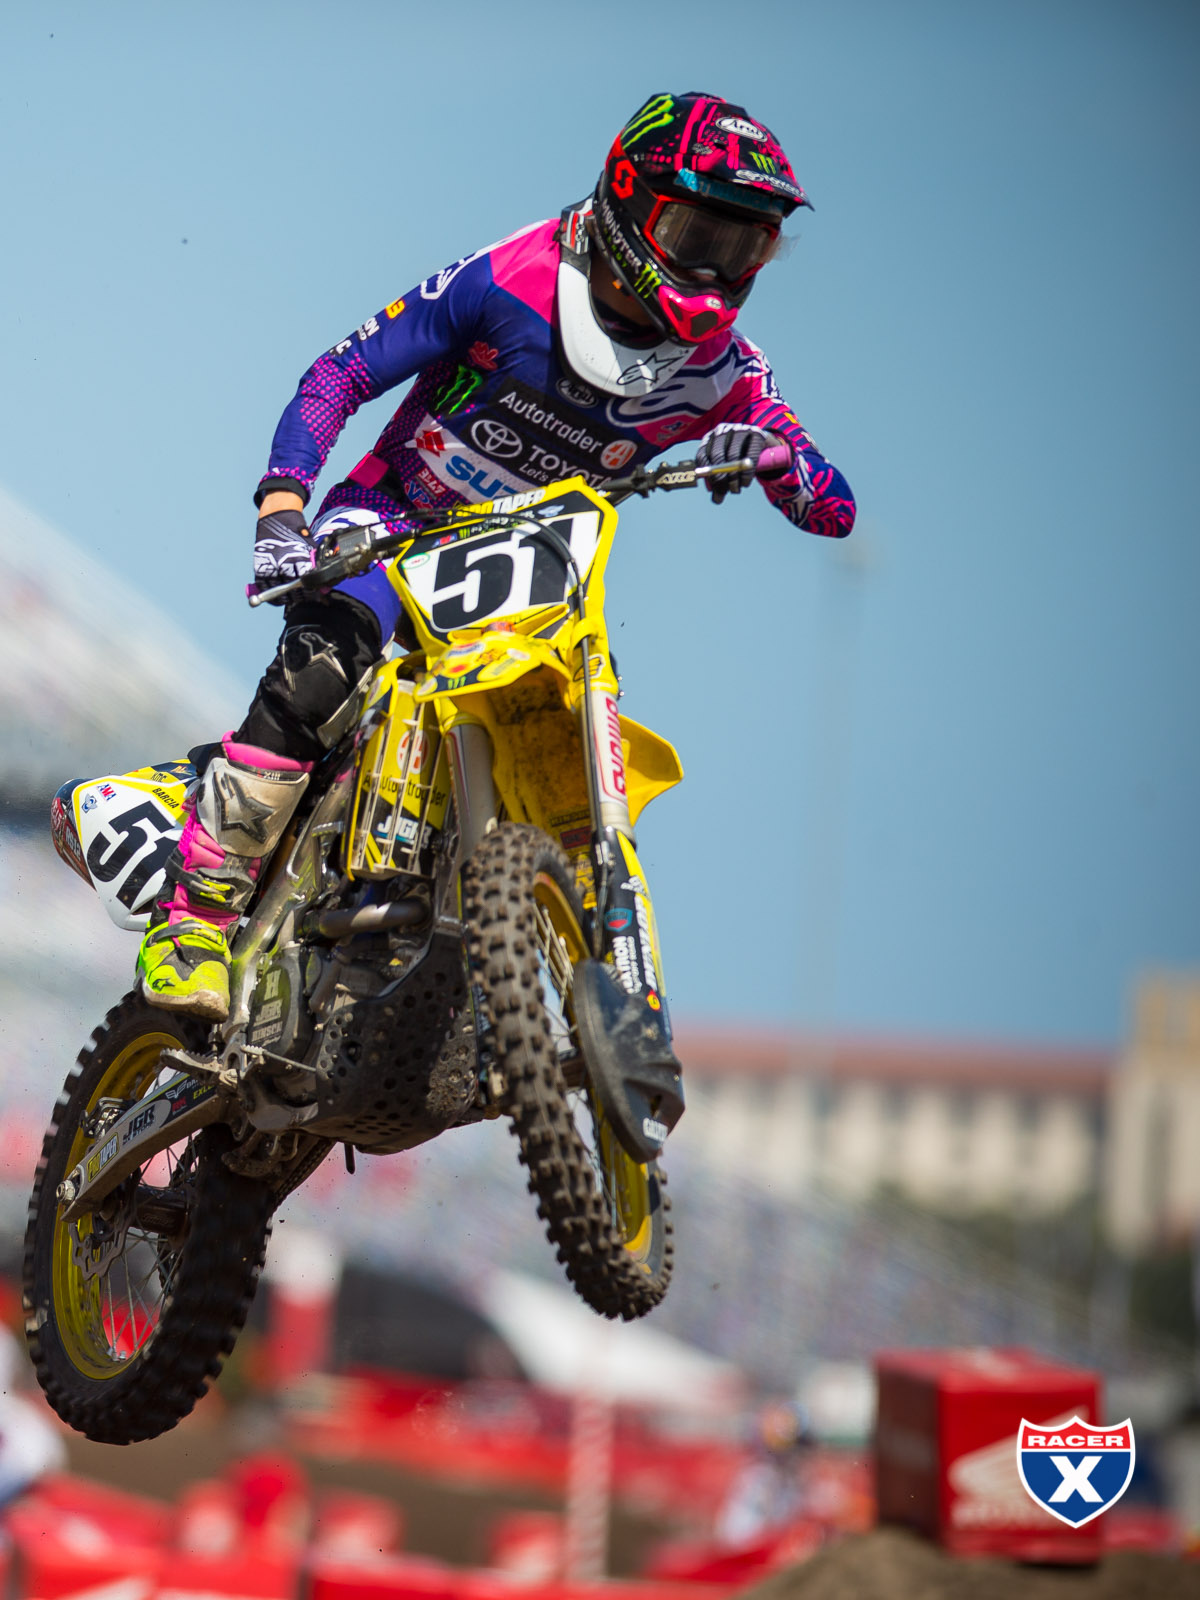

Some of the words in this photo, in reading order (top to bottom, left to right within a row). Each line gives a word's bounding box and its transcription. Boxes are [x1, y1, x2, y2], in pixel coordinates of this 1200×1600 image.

[601, 198, 642, 274] MONSTER
[499, 391, 603, 453] Autotrader
[519, 463, 550, 485] Let's
[432, 517, 574, 630] 51
[152, 787, 179, 809] BARCIA
[86, 800, 181, 910] 51
